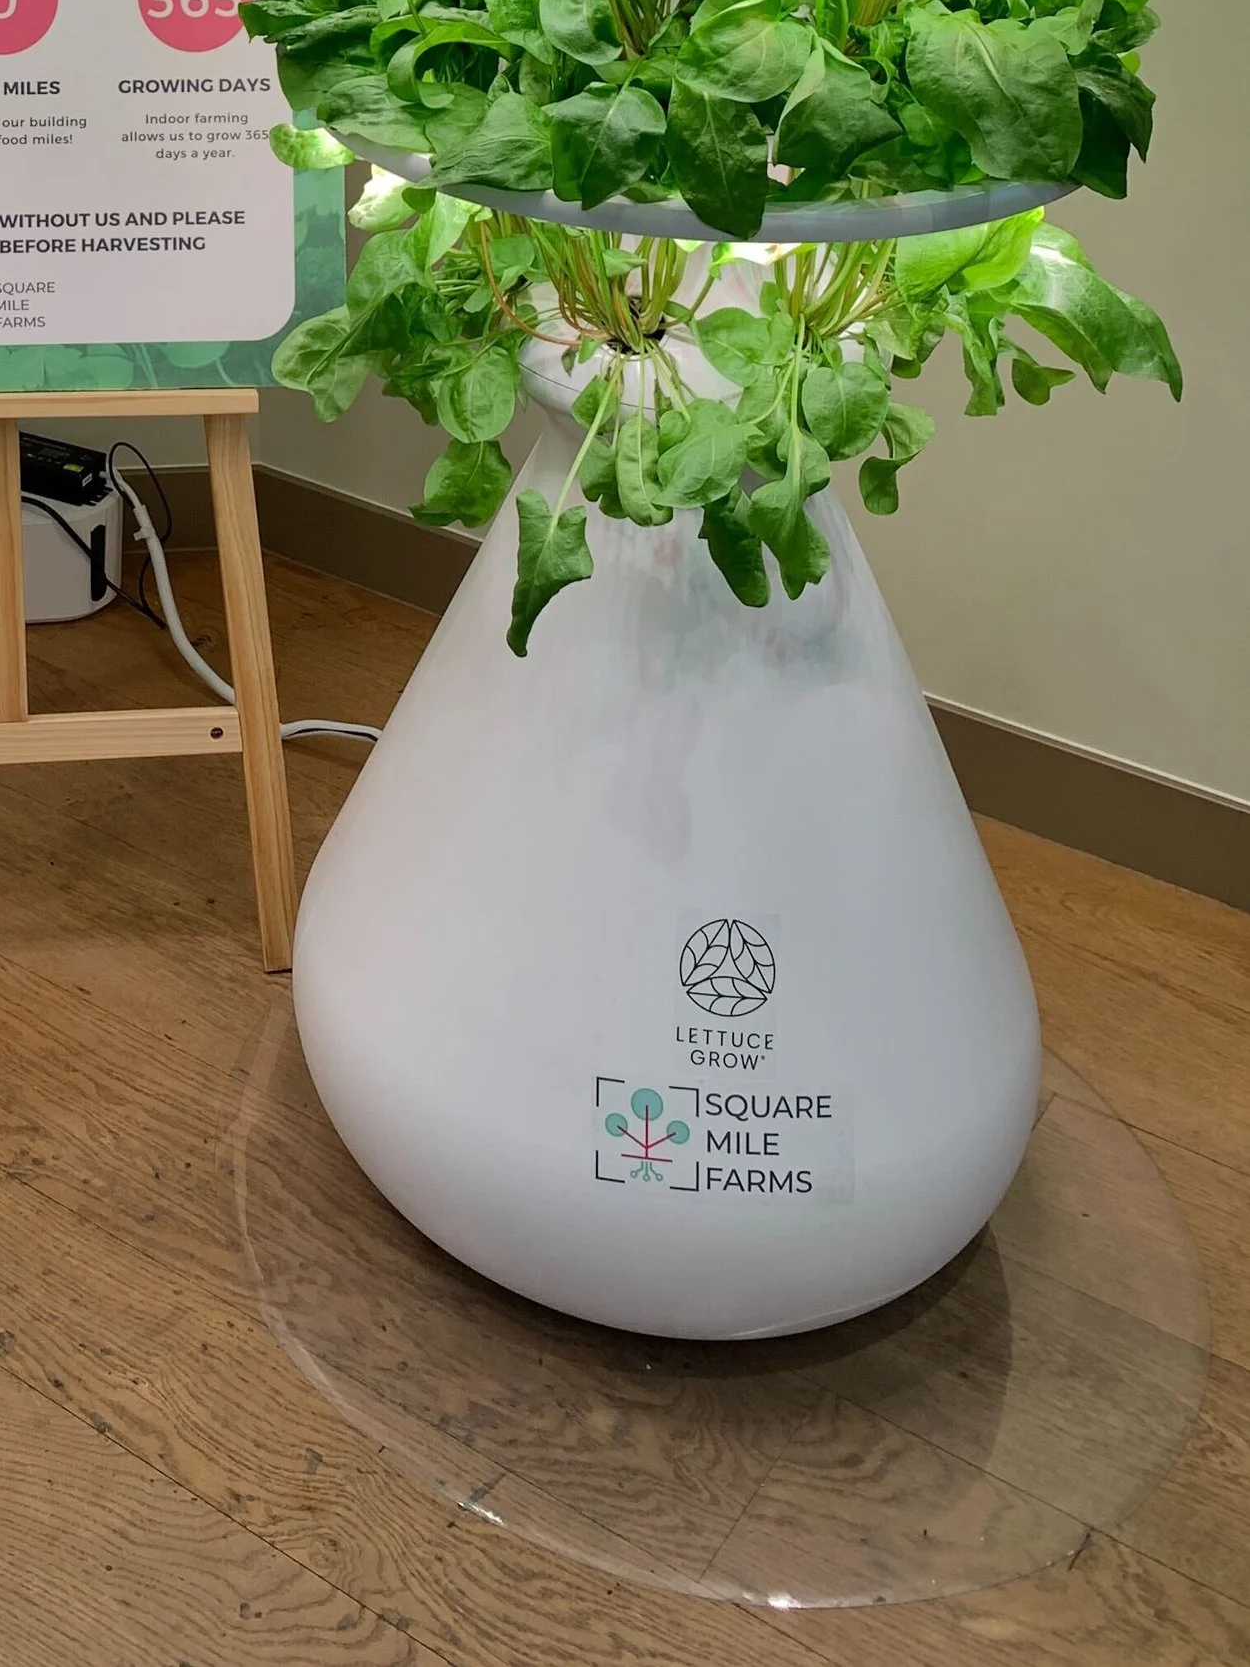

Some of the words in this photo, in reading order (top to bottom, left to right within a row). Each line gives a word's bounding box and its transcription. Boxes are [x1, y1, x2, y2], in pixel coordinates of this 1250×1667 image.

[3, 81, 60, 95] MILES
[118, 79, 213, 94] GROWING
[219, 78, 270, 92] DAYS
[2, 119, 25, 128] our
[30, 116, 87, 129] building
[146, 113, 190, 124] Indoor
[195, 112, 248, 124] farming
[33, 133, 73, 144] miles!
[122, 131, 165, 142] allows
[169, 132, 184, 141] us
[189, 131, 202, 141] to
[207, 131, 241, 143] grow
[245, 130, 269, 140] 365
[156, 148, 186, 160] days
[191, 149, 198, 158] a
[203, 149, 235, 160] year.
[95, 212, 120, 227] US
[125, 212, 167, 226] AND
[173, 210, 245, 225] PLEASE
[0, 239, 76, 254] BEFORE
[81, 236, 205, 253] HARVESTING
[676, 1026, 774, 1050] LETTUCE
[705, 1093, 832, 1121] SQUARE
[707, 1130, 779, 1155] MILE
[707, 1167, 813, 1194] FARMS
